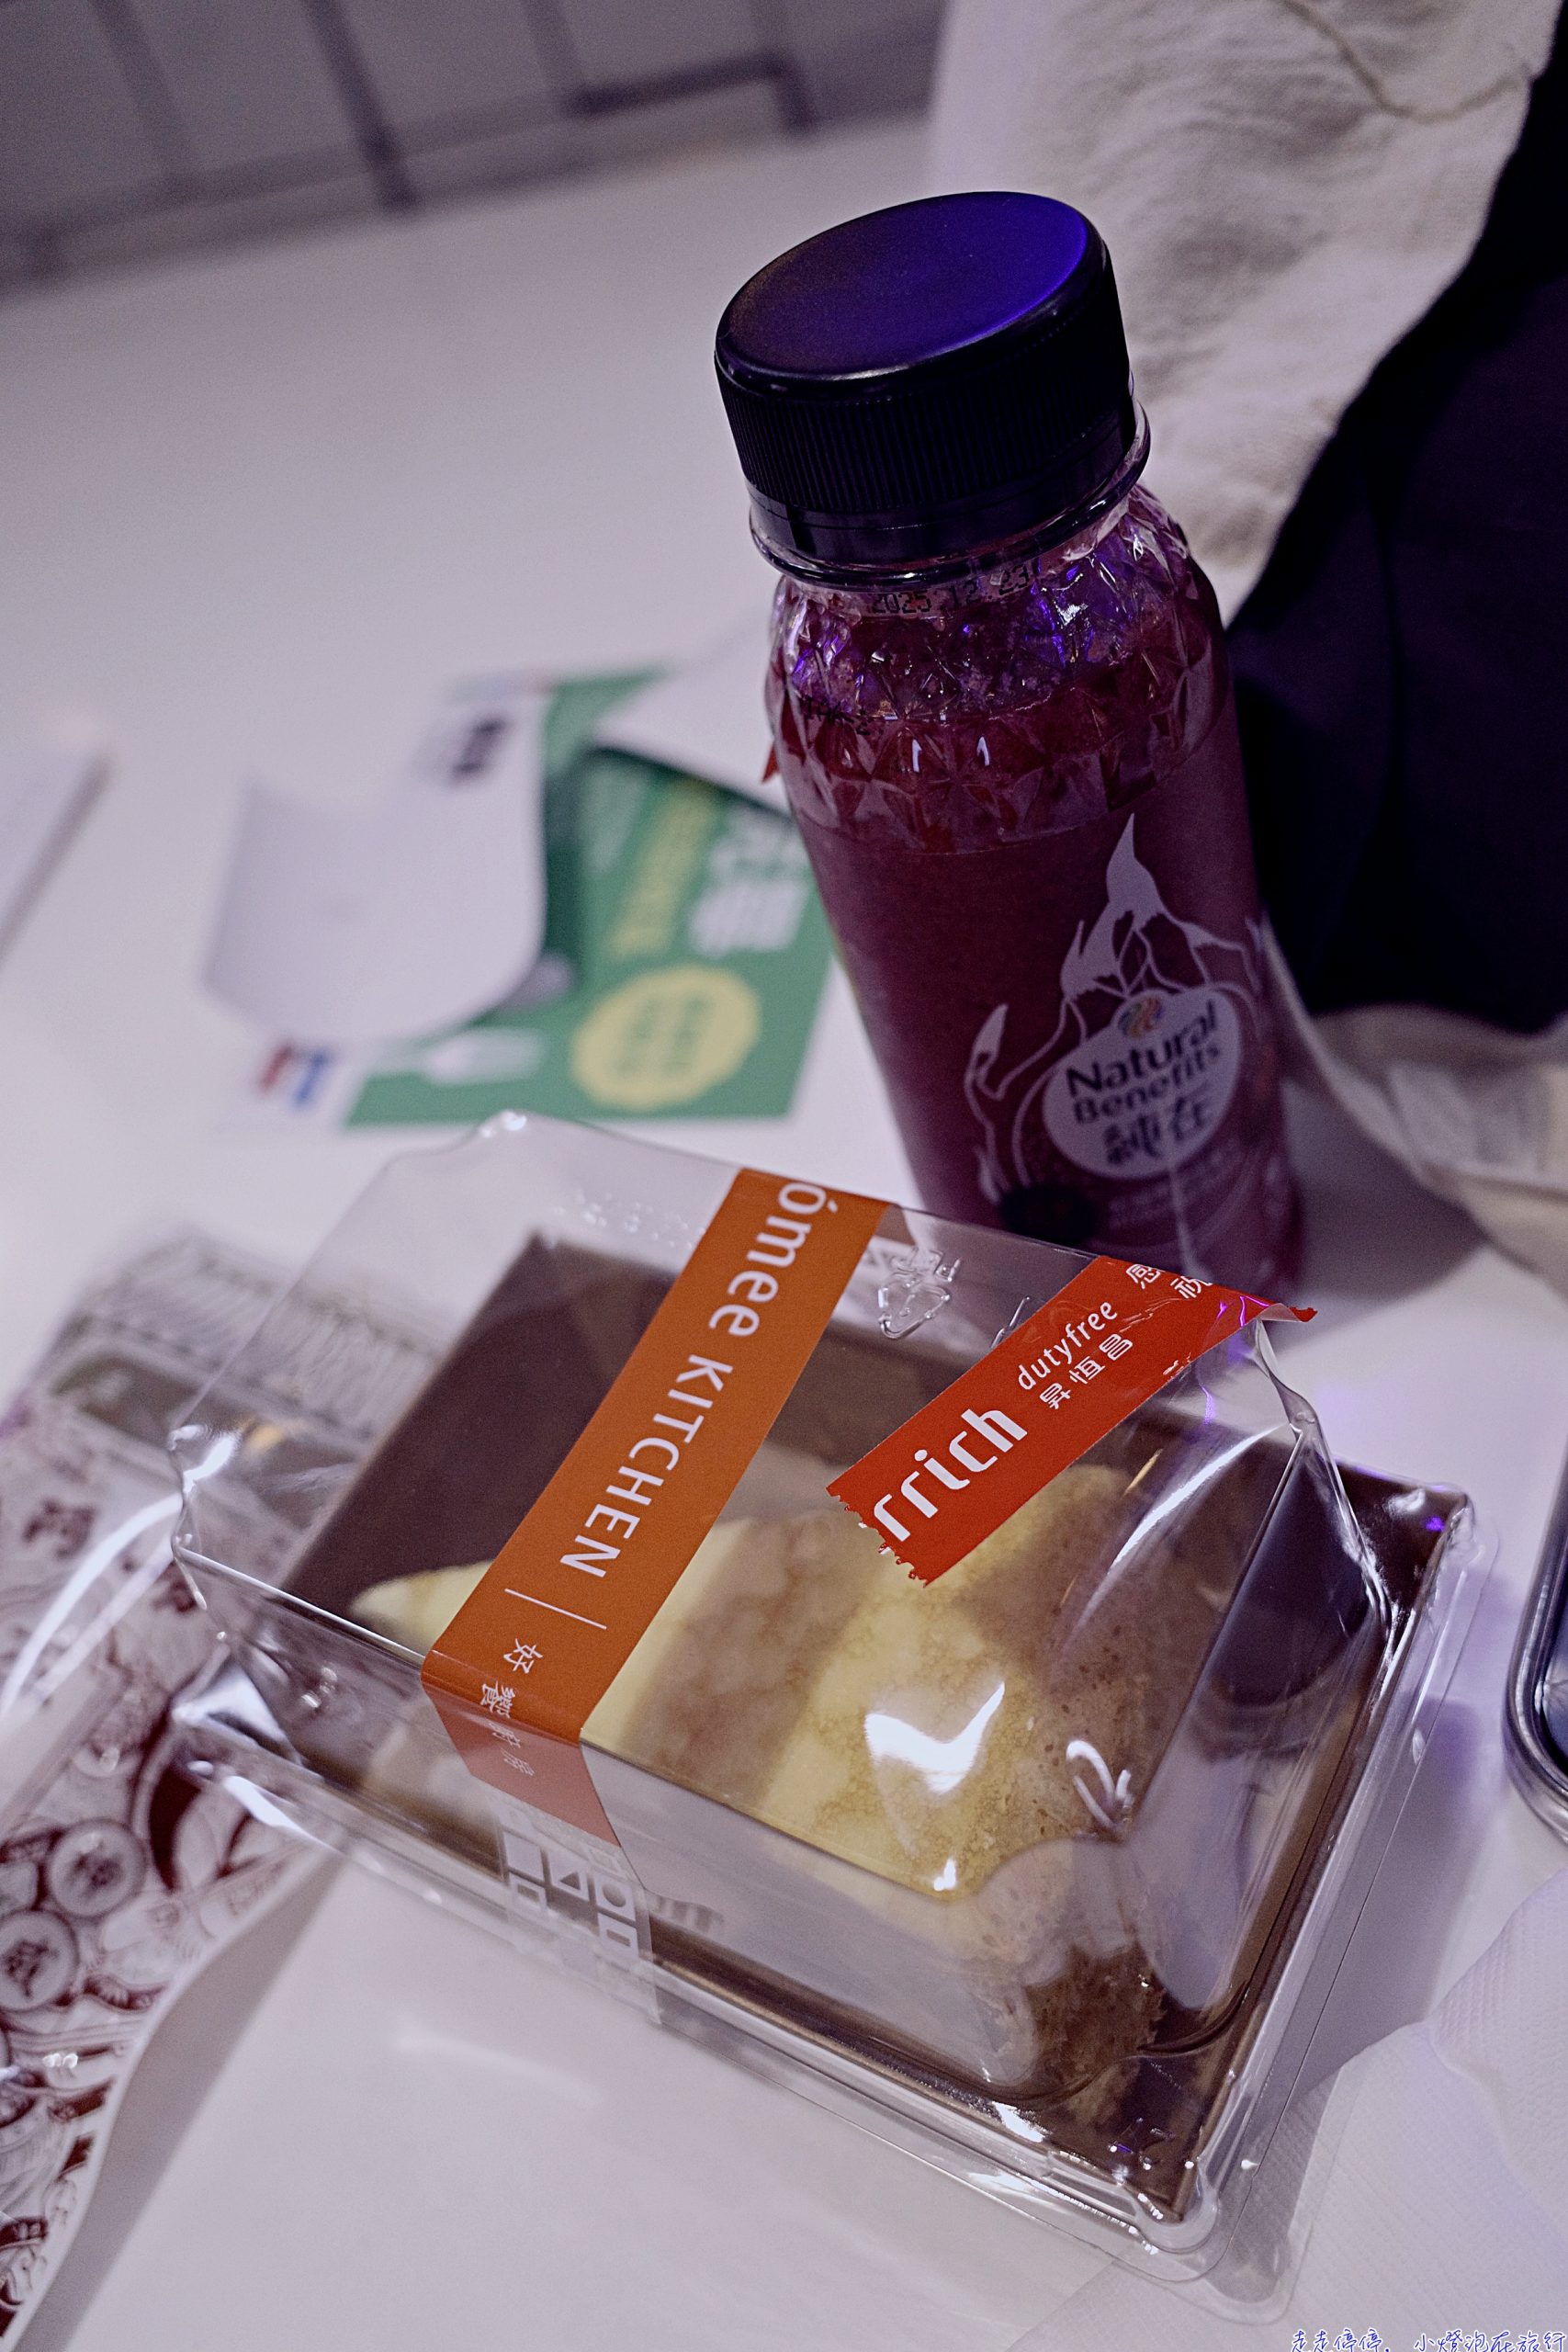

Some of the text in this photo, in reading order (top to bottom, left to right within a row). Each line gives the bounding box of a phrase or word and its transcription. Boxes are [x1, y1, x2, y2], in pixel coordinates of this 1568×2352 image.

[1066, 998, 1219, 1099] Natural
[1072, 1041, 1222, 1125] Benefits
[558, 1182, 839, 1578] ómee KITCHEN
[873, 1301, 1118, 1543] rrich dutyfree
